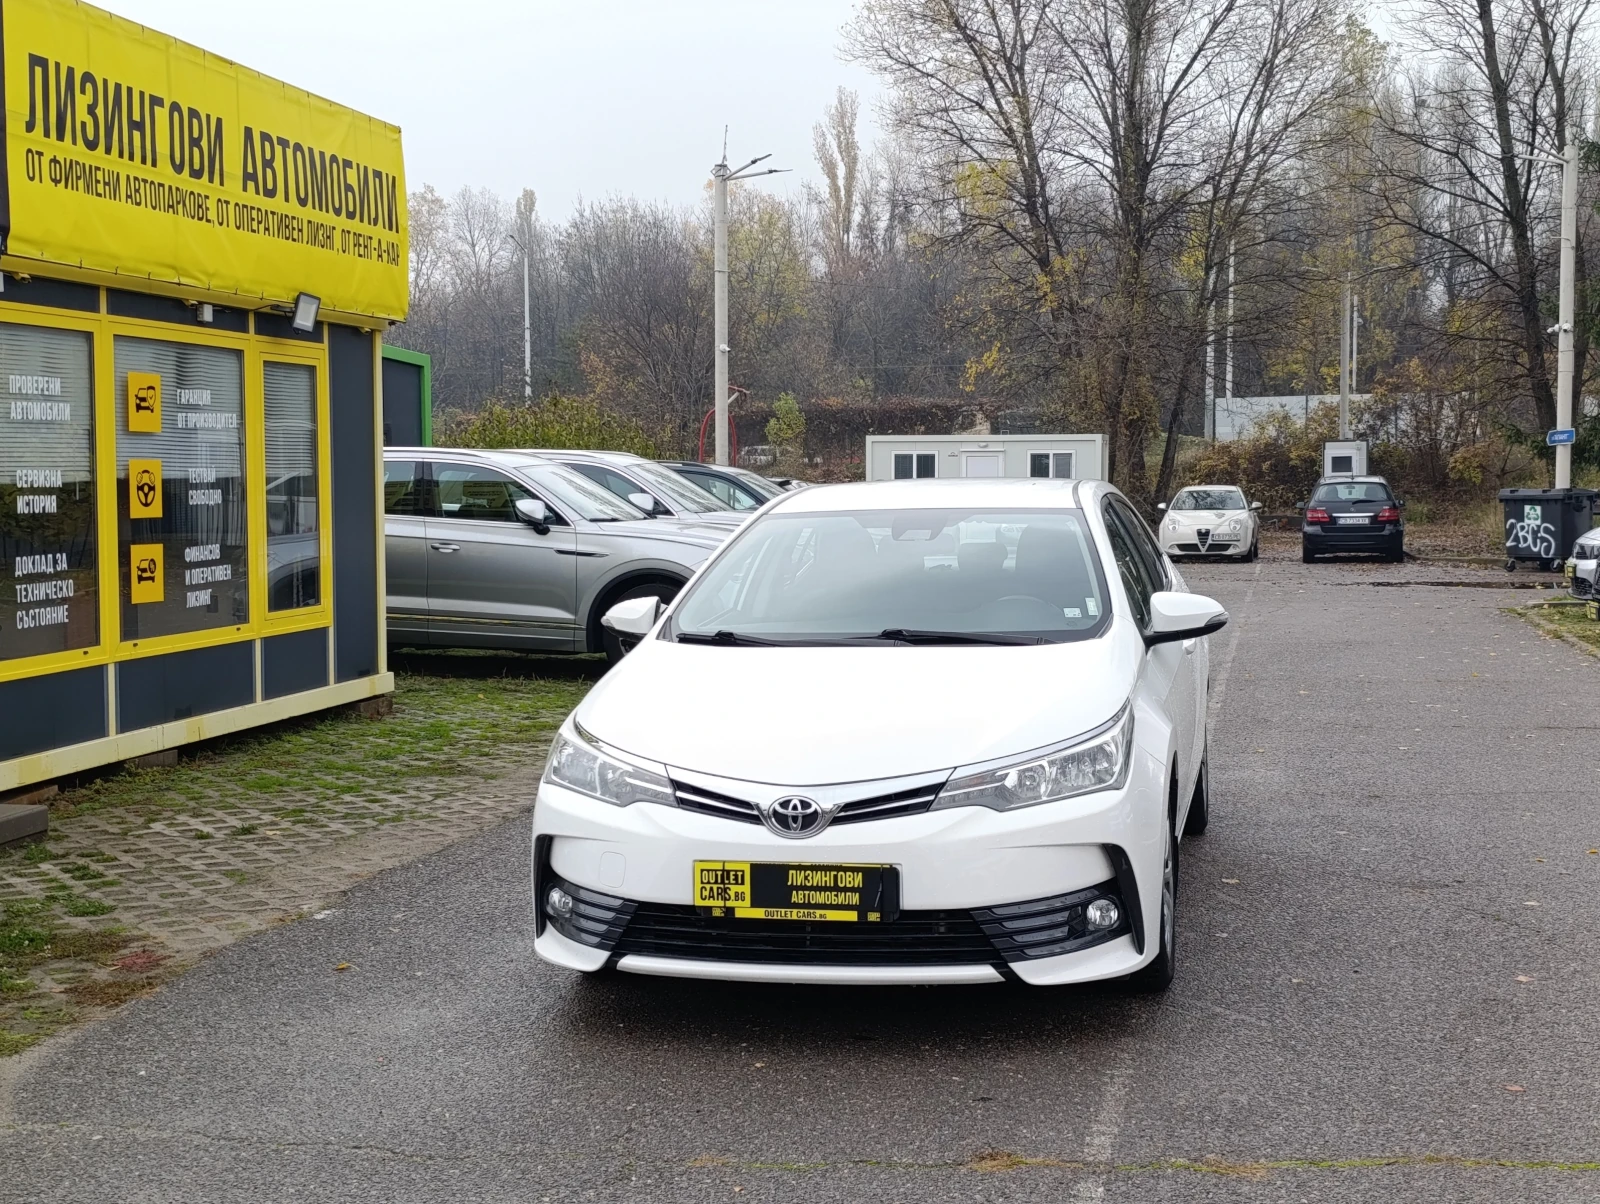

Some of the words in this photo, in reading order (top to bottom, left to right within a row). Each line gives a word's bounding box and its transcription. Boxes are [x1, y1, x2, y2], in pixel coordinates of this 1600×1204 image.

[25, 52, 224, 187] ЛИЗИНГОВИ
[242, 125, 400, 234] АВТОМОБИЛИ
[25, 148, 44, 184] ОТ
[48, 155, 122, 202] ФИРМЕНИ
[125, 174, 215, 228] АВТОПАРКОВЕ,
[216, 198, 230, 228] ОТ
[234, 202, 304, 244] ОПЕРАТИВЕН
[341, 228, 351, 255] ОТ
[9, 375, 61, 395] ПРОВЕРЕНИ
[177, 389, 212, 406] ГАРАНЦИЯ
[10, 401, 71, 421] АВТОМОБИЛИ
[177, 412, 186, 428] ОТ
[187, 412, 237, 430] ПРОИЗВОДИТЕЛ
[16, 469, 63, 489] СЕРВИЗНА
[188, 465, 216, 484] ТЕСТВАЙ
[17, 495, 57, 514] ИСТОРИЯ
[188, 489, 222, 506] СВОБОДНО
[184, 544, 221, 563] ФИНАНСОВ
[15, 554, 54, 577] ДОКЛАД
[56, 553, 68, 571] ЗА
[185, 569, 191, 585] И
[191, 564, 232, 584] ОПЕРАТИВЕН
[15, 579, 74, 603] ТЕХНИЧЕСКО
[186, 589, 212, 608] ЛИЗИНГ
[16, 605, 69, 629] СЪСТОЯНИЕ
[701, 870, 744, 884] OUTLET
[787, 869, 863, 888] ЛИЗИНГОВИ
[700, 886, 746, 902] CARS.BG
[791, 890, 860, 906] АВТОМОБИЛИ
[764, 909, 794, 918] OUTLET
[796, 910, 827, 920] CARS.BG
